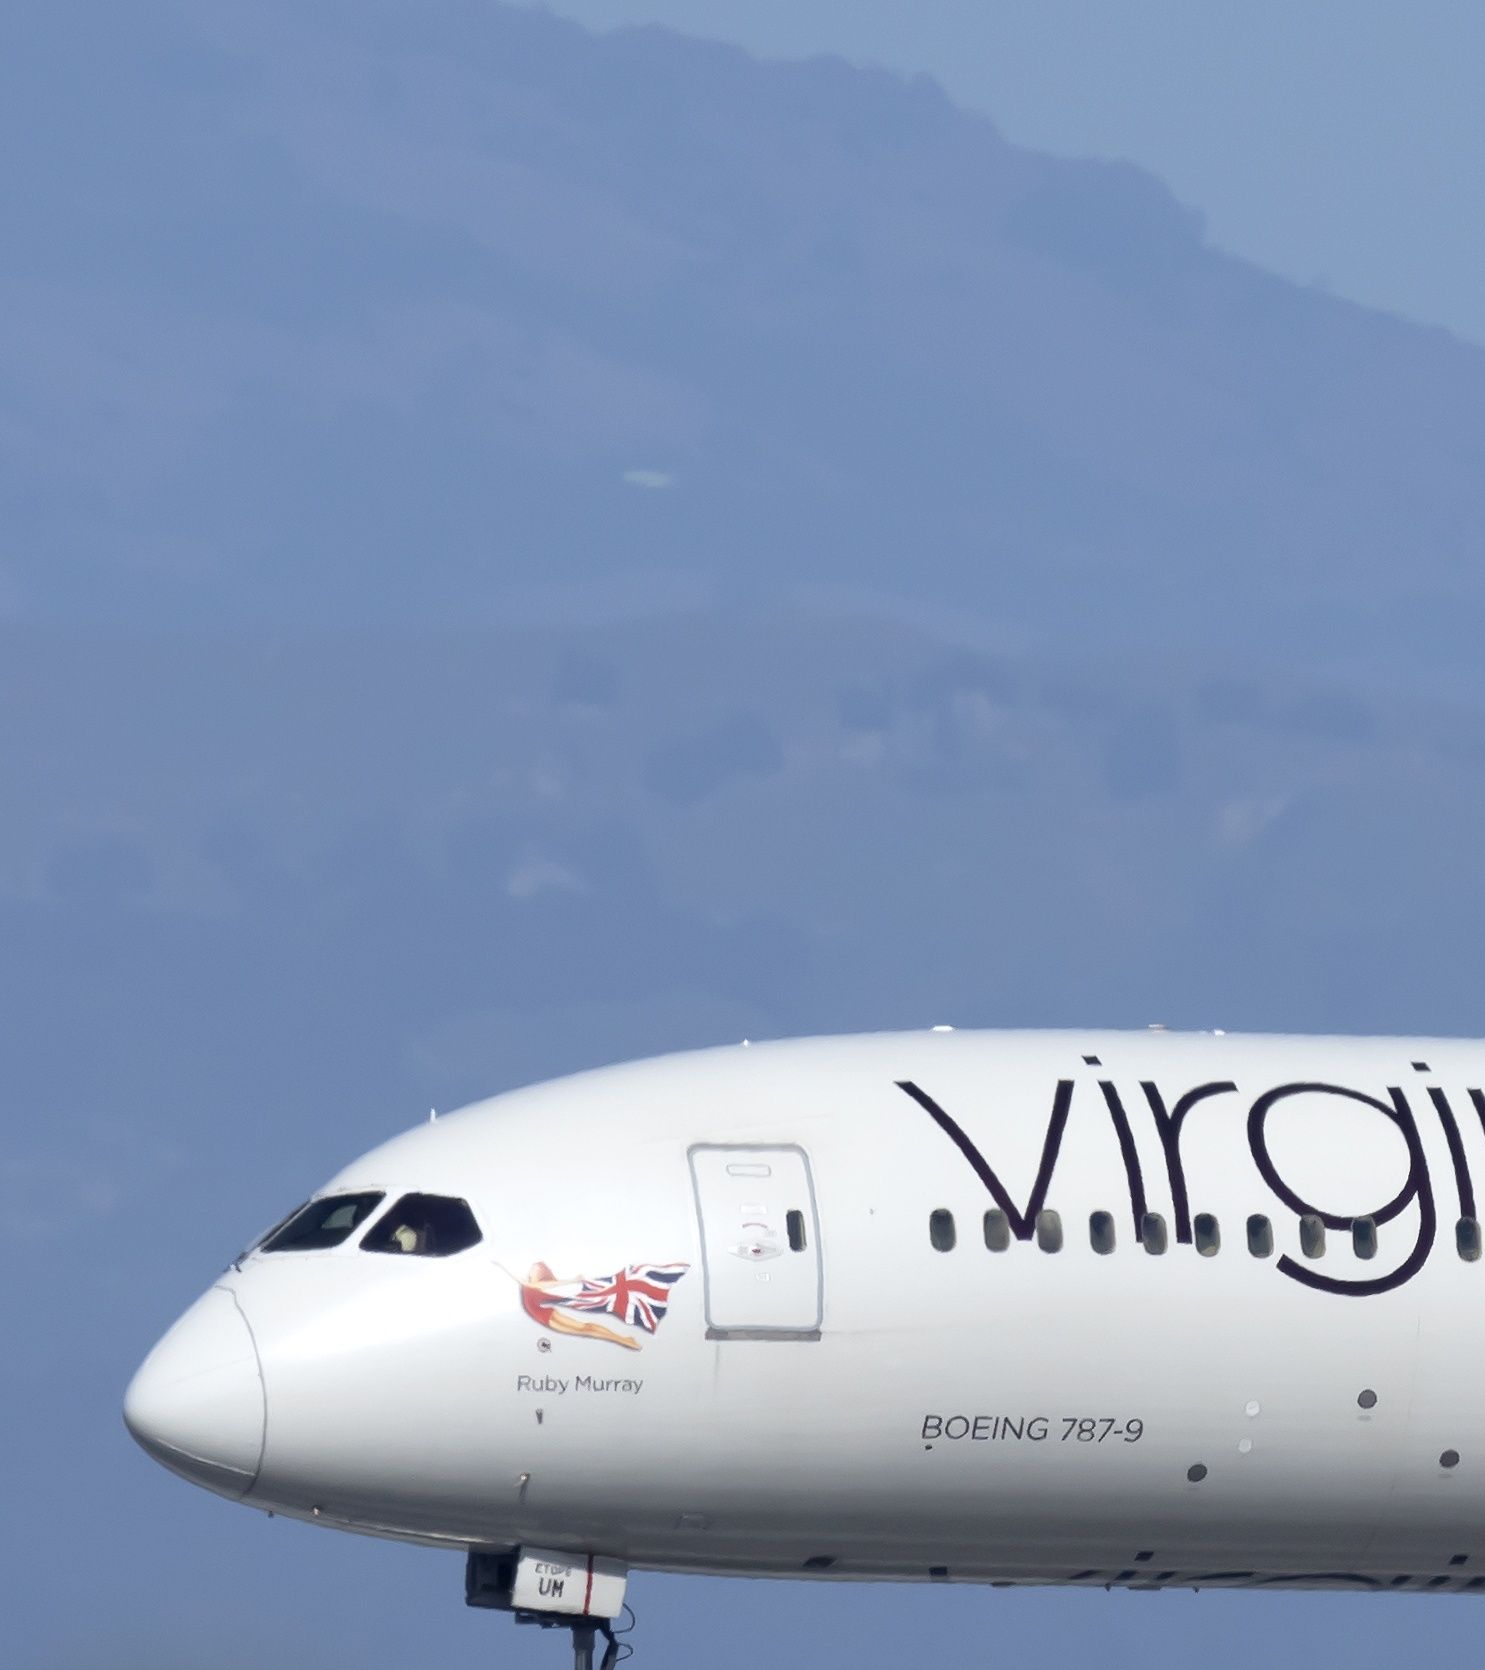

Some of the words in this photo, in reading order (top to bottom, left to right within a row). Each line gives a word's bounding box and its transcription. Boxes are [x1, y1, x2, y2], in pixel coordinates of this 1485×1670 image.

[516, 1375, 569, 1395] Ruby
[575, 1375, 644, 1395] Murray
[921, 1414, 1049, 1441] BOEING
[1061, 1417, 1144, 1443] 787-9
[539, 1577, 565, 1598] UM
